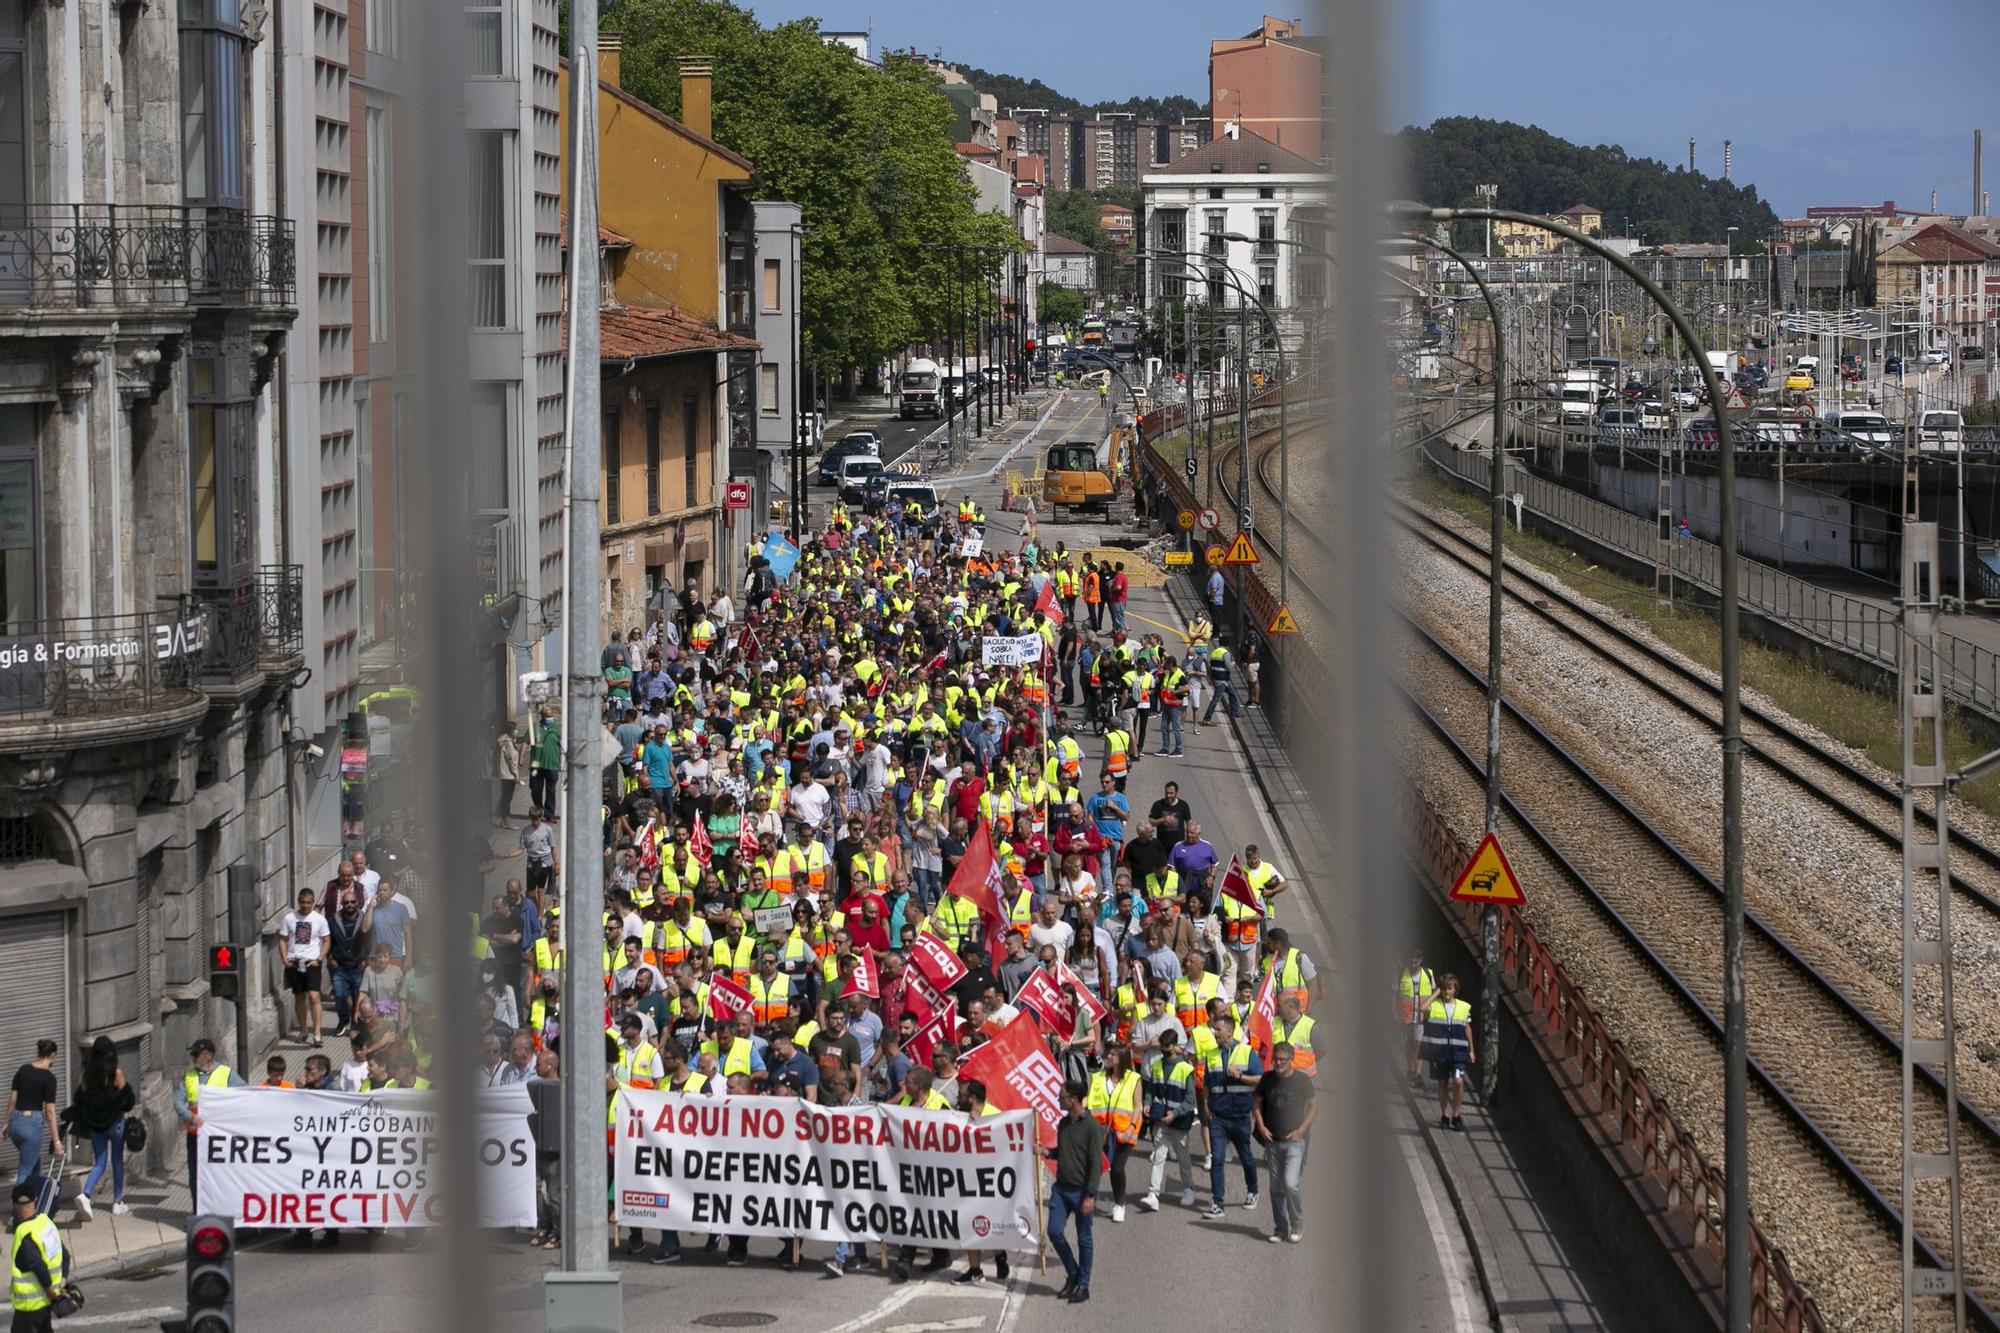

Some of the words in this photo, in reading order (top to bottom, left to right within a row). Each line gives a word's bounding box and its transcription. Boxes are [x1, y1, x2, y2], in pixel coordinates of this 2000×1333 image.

[1187, 459, 1195, 475] S
[731, 489, 746, 501] dfg
[1180, 515, 1193, 524] 20
[34, 643, 48, 659] &
[54, 637, 139, 661] Formación
[294, 1115, 434, 1133] SAINT-GOBAIN
[654, 1099, 731, 1137] AQUÍ
[741, 1108, 785, 1139] NO
[795, 1109, 895, 1147] SOBRA
[903, 1119, 996, 1153] NADIE
[1005, 1122, 1025, 1152] !!
[208, 1135, 293, 1164] ERES
[313, 1136, 333, 1164] Y
[351, 1136, 527, 1166] DESPOS
[302, 1169, 363, 1189] PARA
[376, 1169, 427, 1189] LOS
[635, 1146, 673, 1178] EN
[684, 1150, 824, 1187] DEFENSA
[830, 1159, 888, 1192] DEL
[899, 1163, 1016, 1199] EMPLEO
[625, 1193, 655, 1205] CCOO
[692, 1192, 732, 1224] EN
[742, 1195, 834, 1230] SAINT
[844, 1202, 961, 1240] GOBAIN
